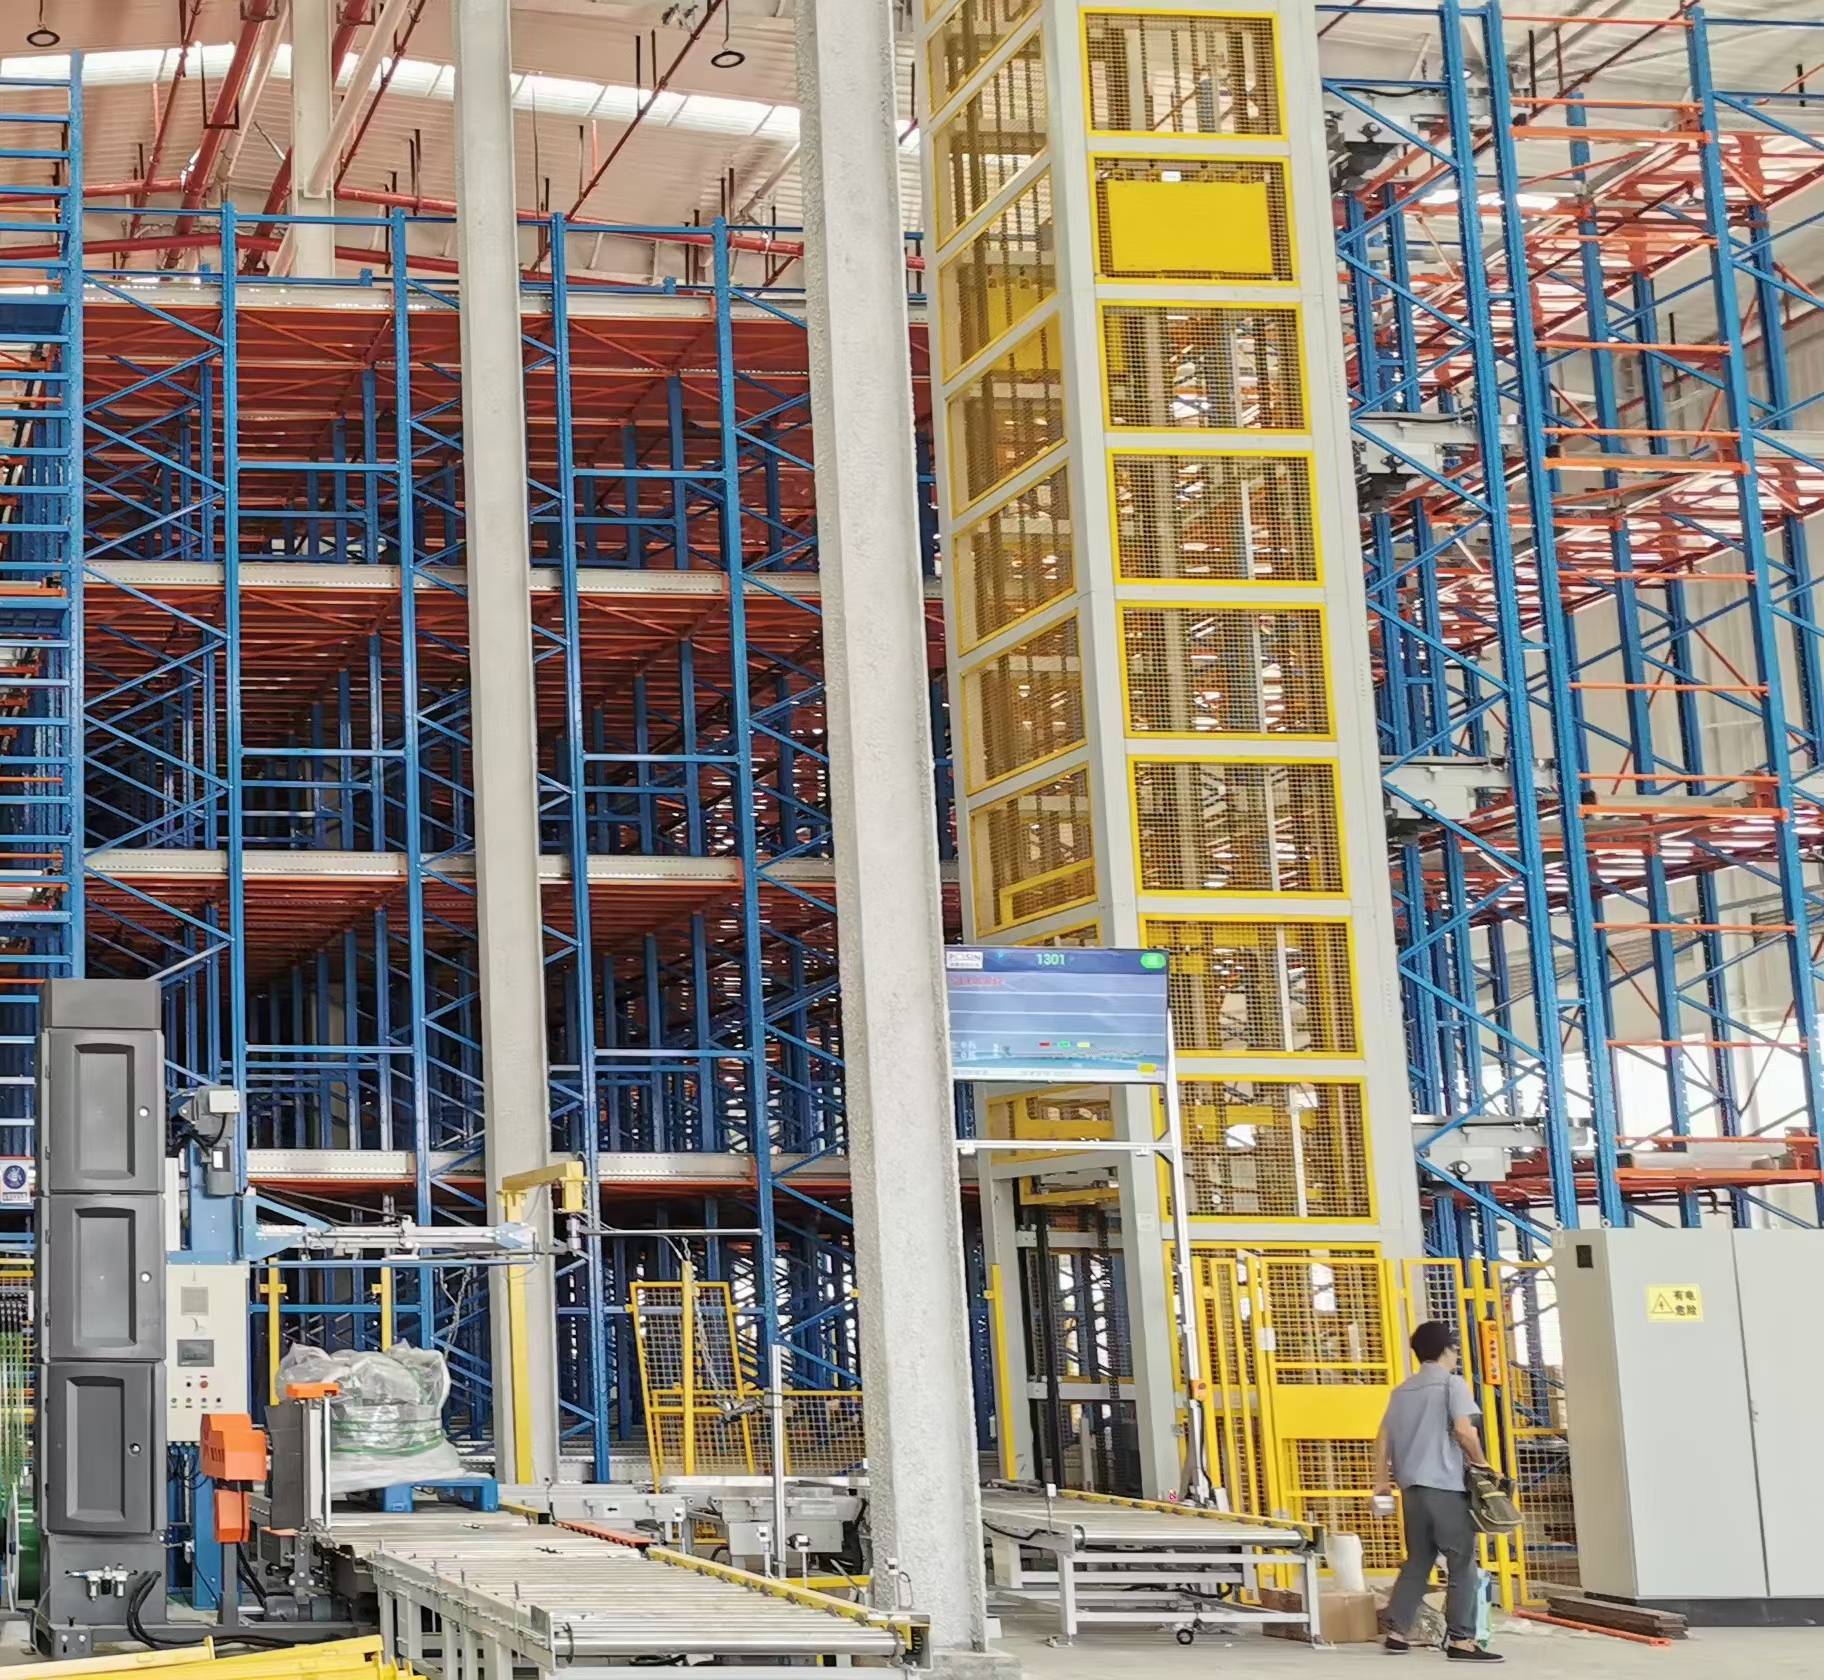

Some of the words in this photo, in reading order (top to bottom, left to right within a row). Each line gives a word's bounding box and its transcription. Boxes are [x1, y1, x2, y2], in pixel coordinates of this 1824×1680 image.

[1036, 953, 1065, 966] 1301
[1673, 1290, 1696, 1301] 有电
[1675, 1305, 1697, 1316] 危险
